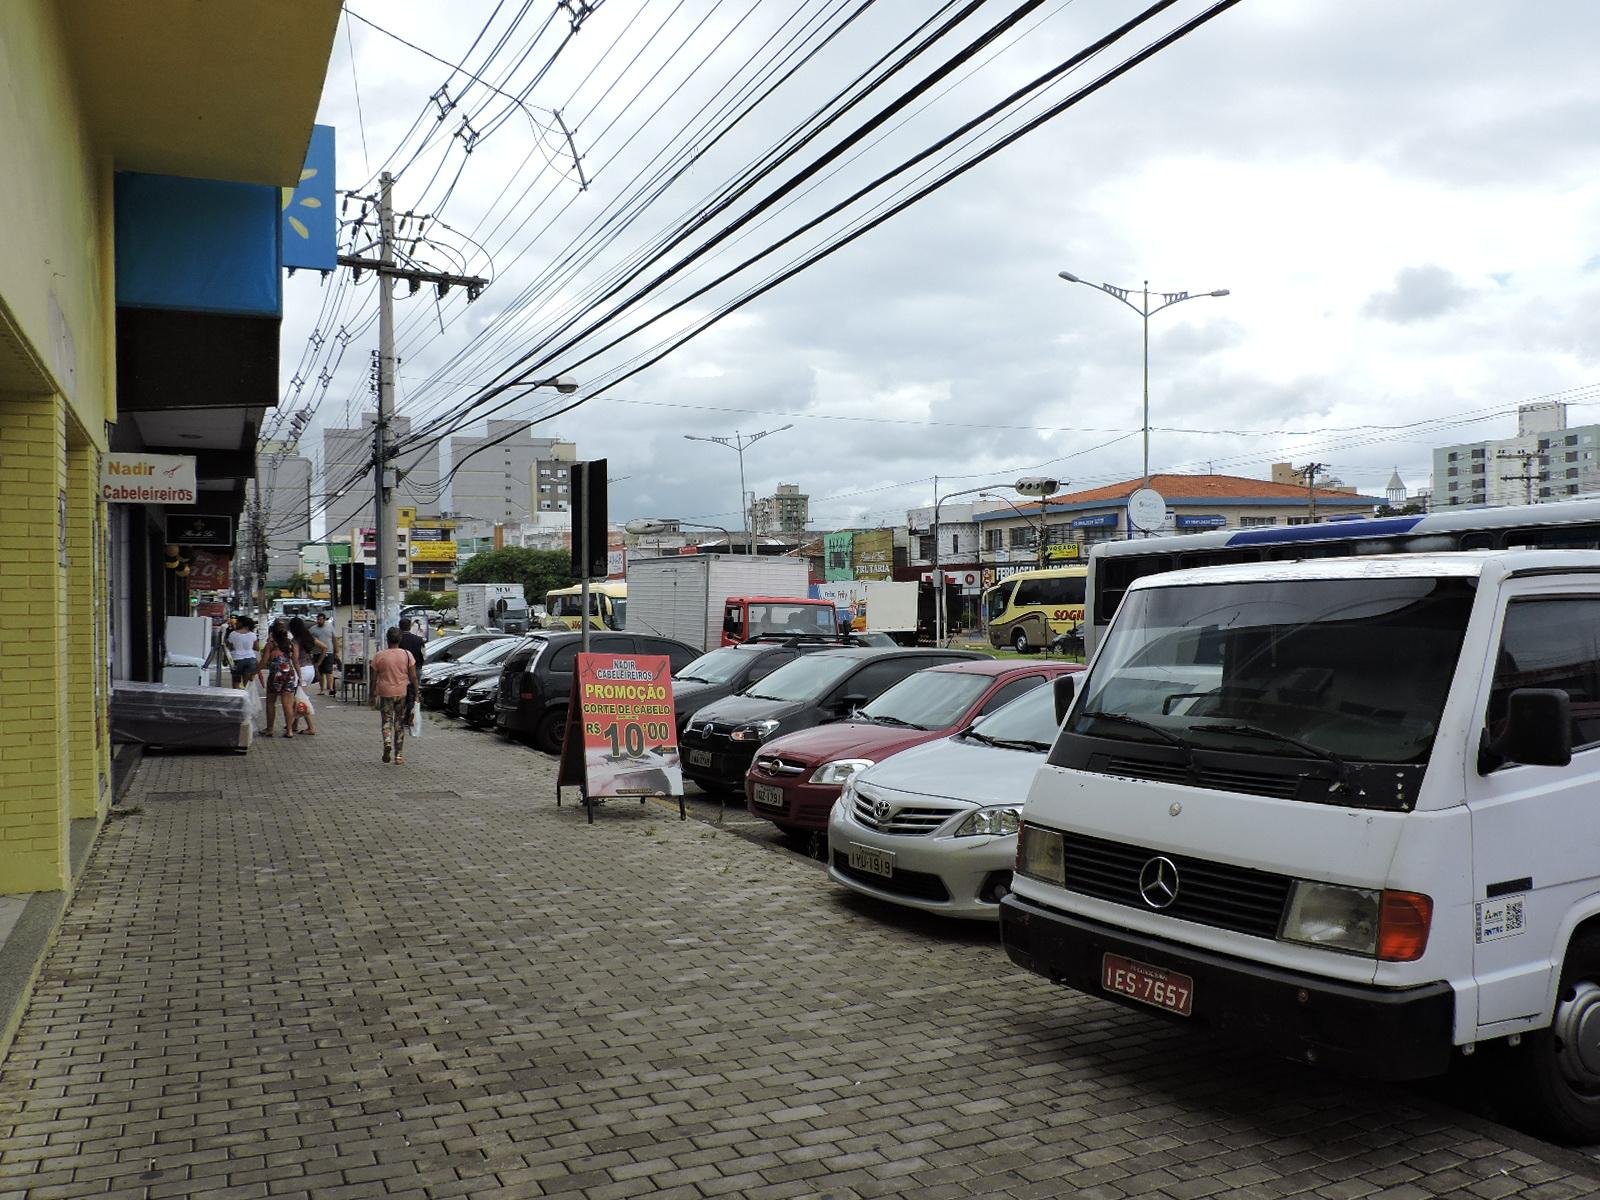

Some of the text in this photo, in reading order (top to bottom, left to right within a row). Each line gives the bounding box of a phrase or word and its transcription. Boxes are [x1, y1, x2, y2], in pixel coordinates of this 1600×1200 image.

[108, 461, 155, 475] Nadir
[103, 484, 193, 501] Cabeleireiros
[613, 660, 636, 669] NADIR
[597, 669, 653, 680] CABELEIREIROS
[585, 684, 666, 702] PROMOÇÃO
[583, 703, 671, 715] CORTE DE CABELO
